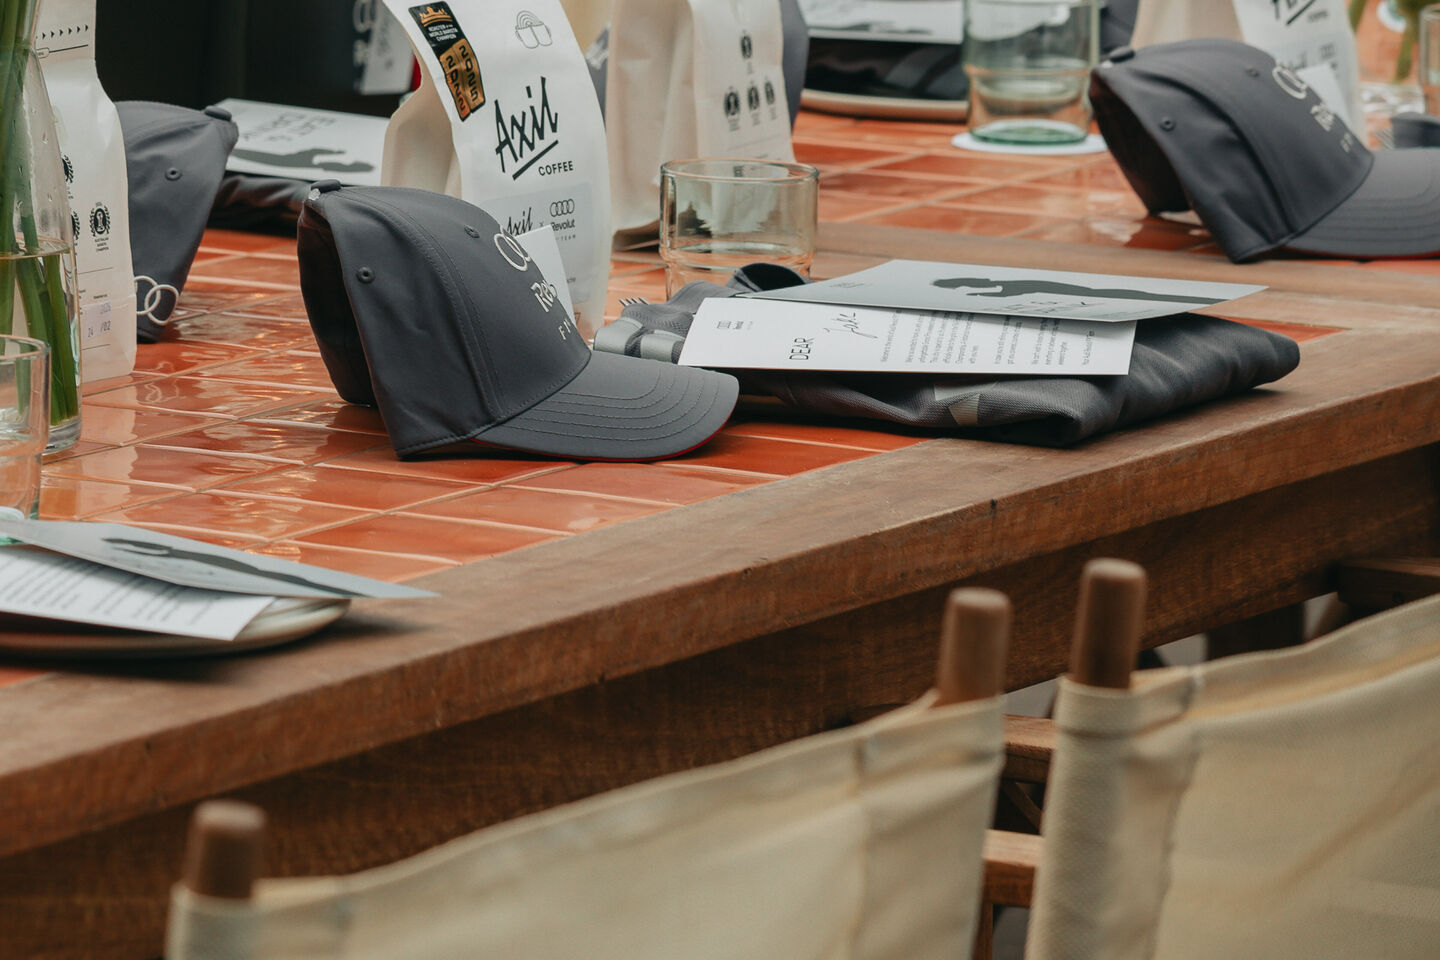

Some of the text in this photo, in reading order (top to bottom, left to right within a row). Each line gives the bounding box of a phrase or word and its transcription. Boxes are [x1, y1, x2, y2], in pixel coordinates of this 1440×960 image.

[459, 45, 479, 102] 2025
[494, 76, 558, 173] Axil
[538, 160, 574, 176] COFFEE
[789, 337, 814, 360] DEAR
